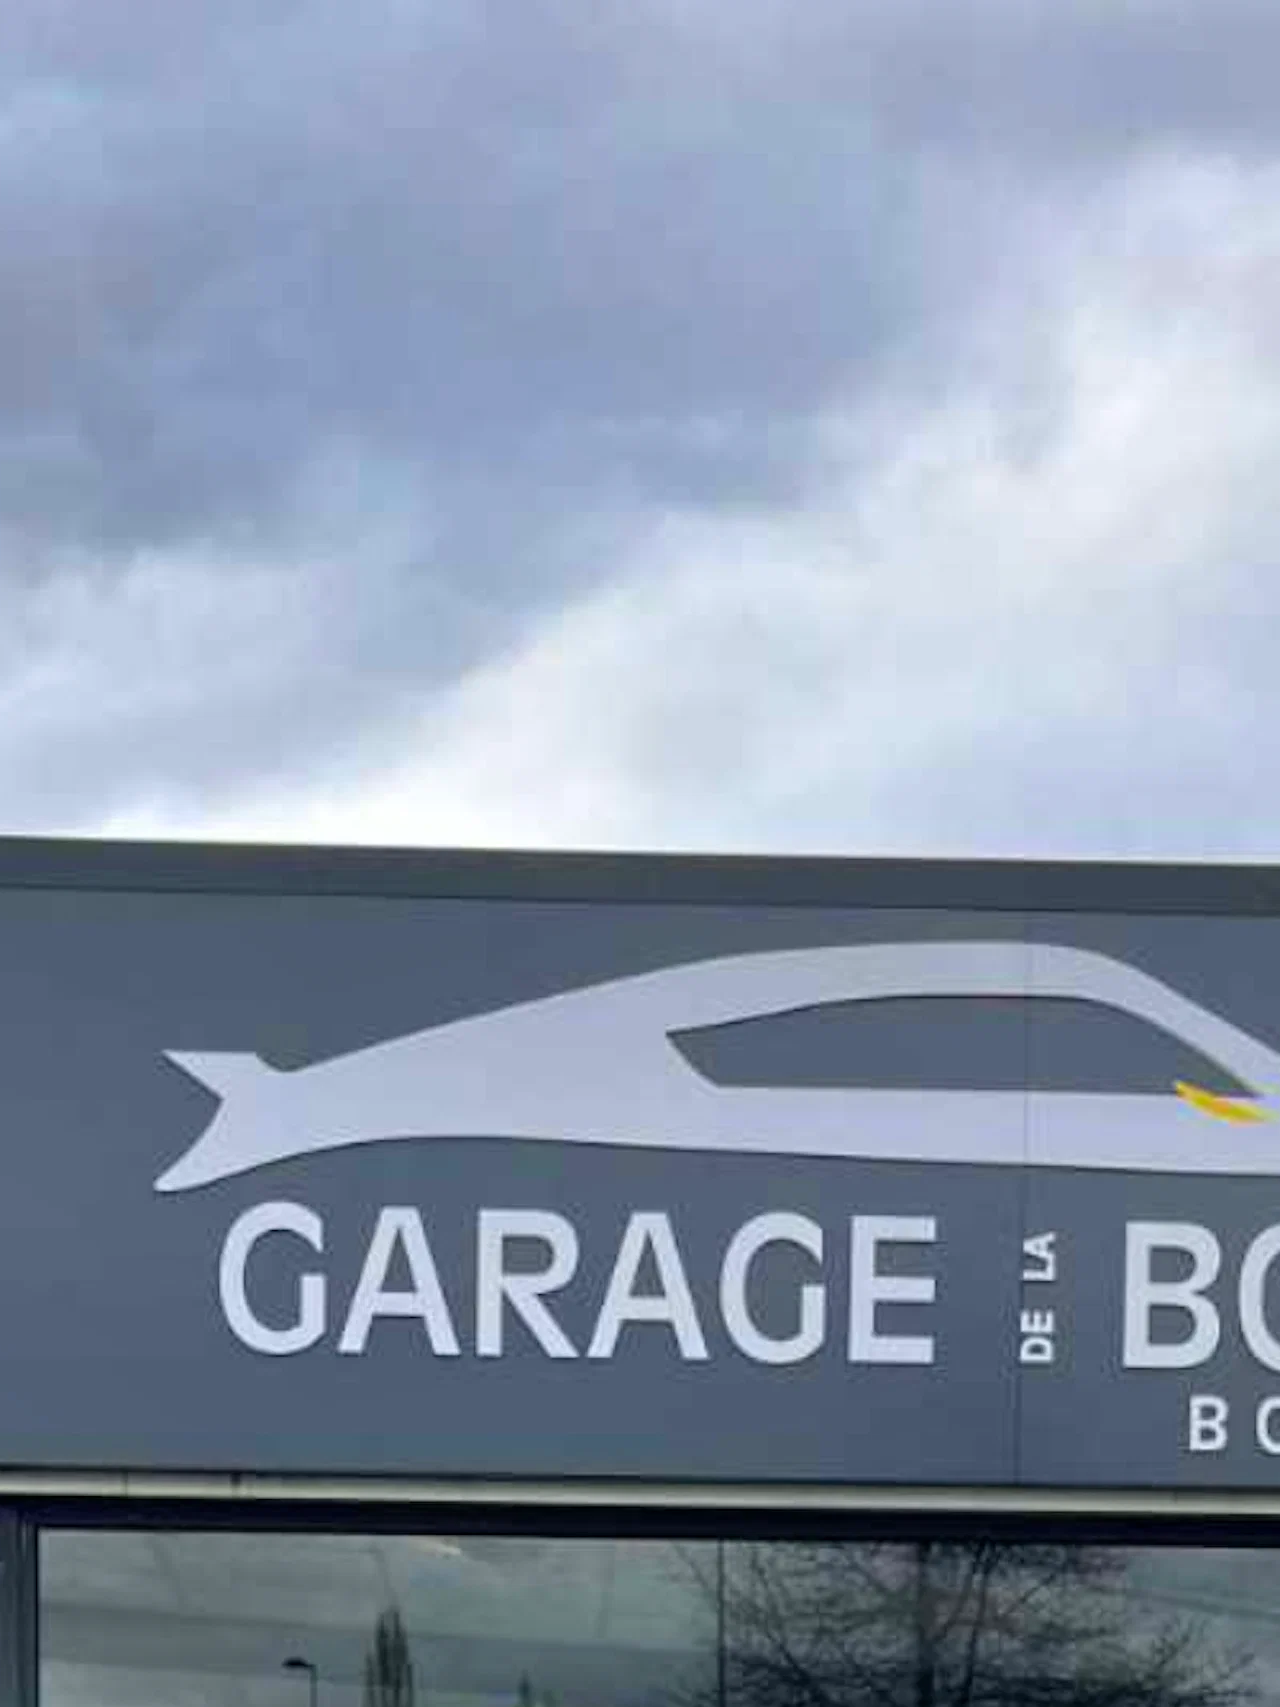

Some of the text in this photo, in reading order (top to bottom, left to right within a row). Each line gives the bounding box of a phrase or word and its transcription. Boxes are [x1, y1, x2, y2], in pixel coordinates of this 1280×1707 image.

[219, 1200, 937, 1364] GARAGE
[1020, 1231, 1056, 1364] DE LA
